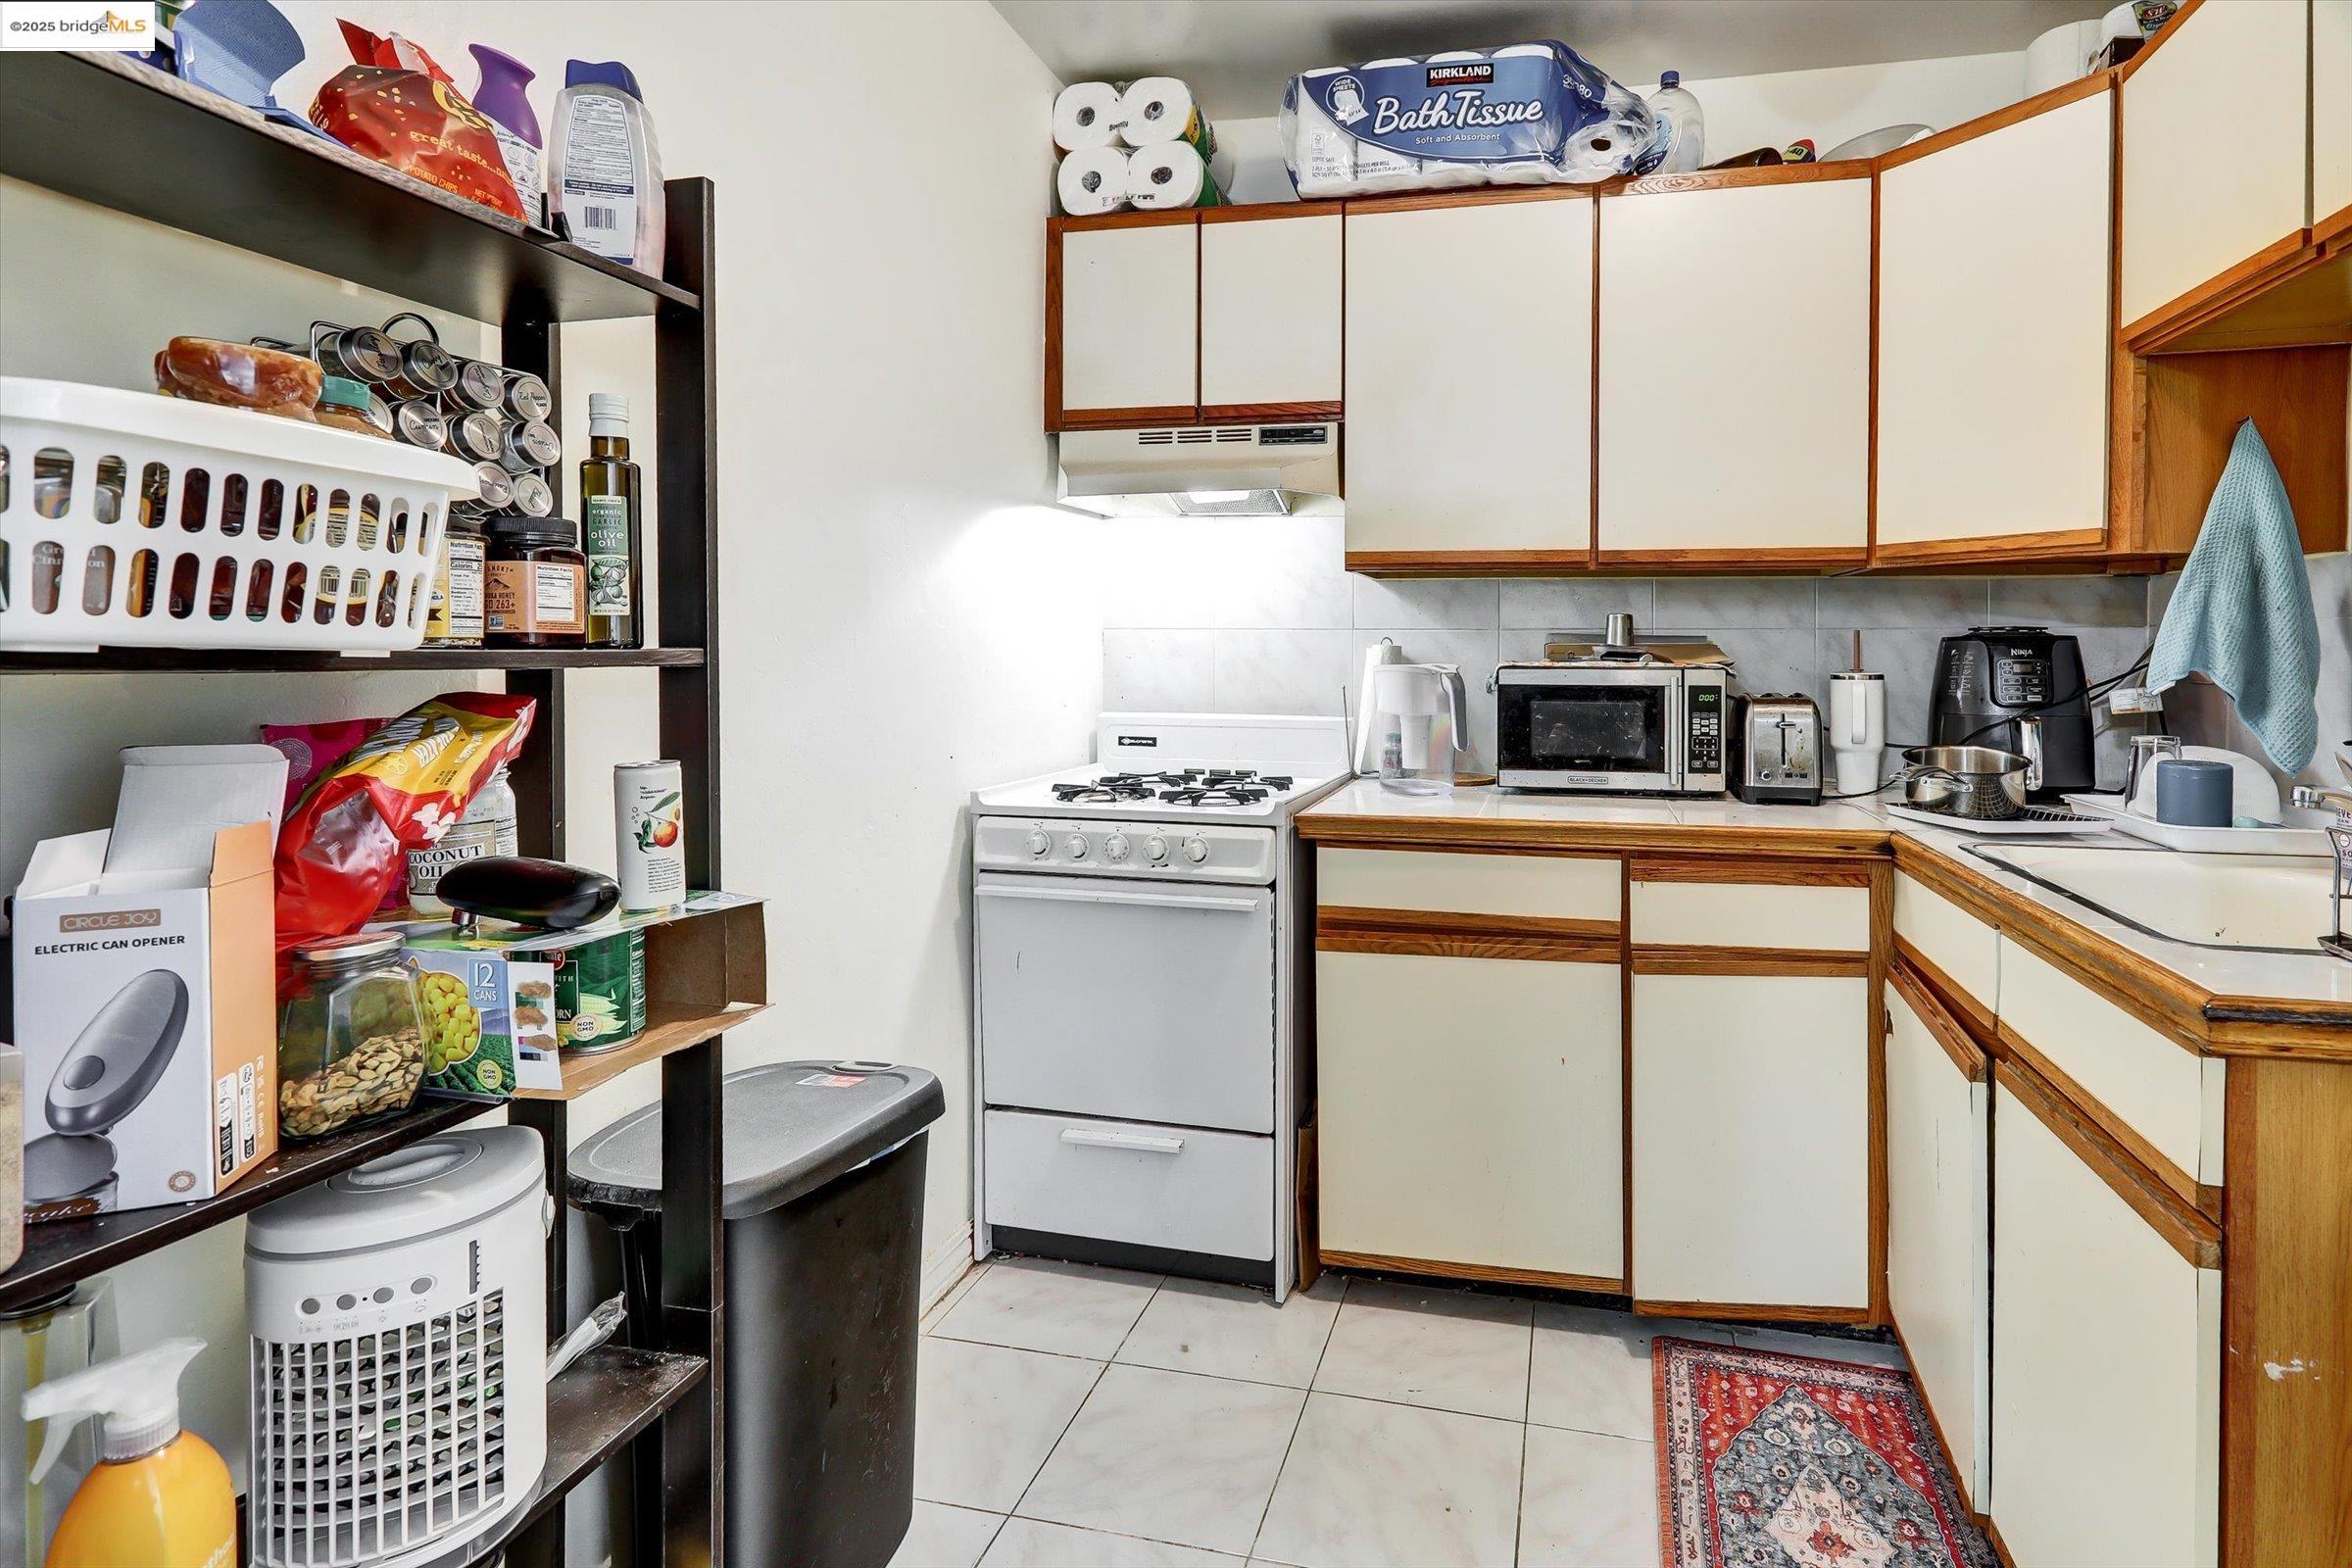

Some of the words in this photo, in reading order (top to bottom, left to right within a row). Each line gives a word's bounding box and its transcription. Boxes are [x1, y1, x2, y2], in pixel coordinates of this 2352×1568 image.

[1430, 64, 1492, 79] KIRKLAND
[1374, 91, 1455, 134] Bath
[1453, 90, 1544, 126] Tissue
[410, 130, 454, 151] great
[1415, 136, 1433, 145] Soft
[1436, 134, 1451, 143] and
[1454, 132, 1500, 142] Absorbent
[409, 166, 438, 185] POTATO
[438, 176, 459, 194] CHIPS
[591, 530, 624, 539] olive
[496, 600, 515, 609] 263+
[2010, 648, 2033, 657] NINJA
[409, 845, 482, 863] COCONUT
[64, 914, 120, 929] CIRCLE
[124, 912, 157, 926] JOY
[34, 941, 99, 955] ELECTRIC
[102, 939, 128, 950] CAN
[132, 936, 185, 948] OPENER
[474, 962, 496, 988] 12
[473, 990, 497, 1002] CANS
